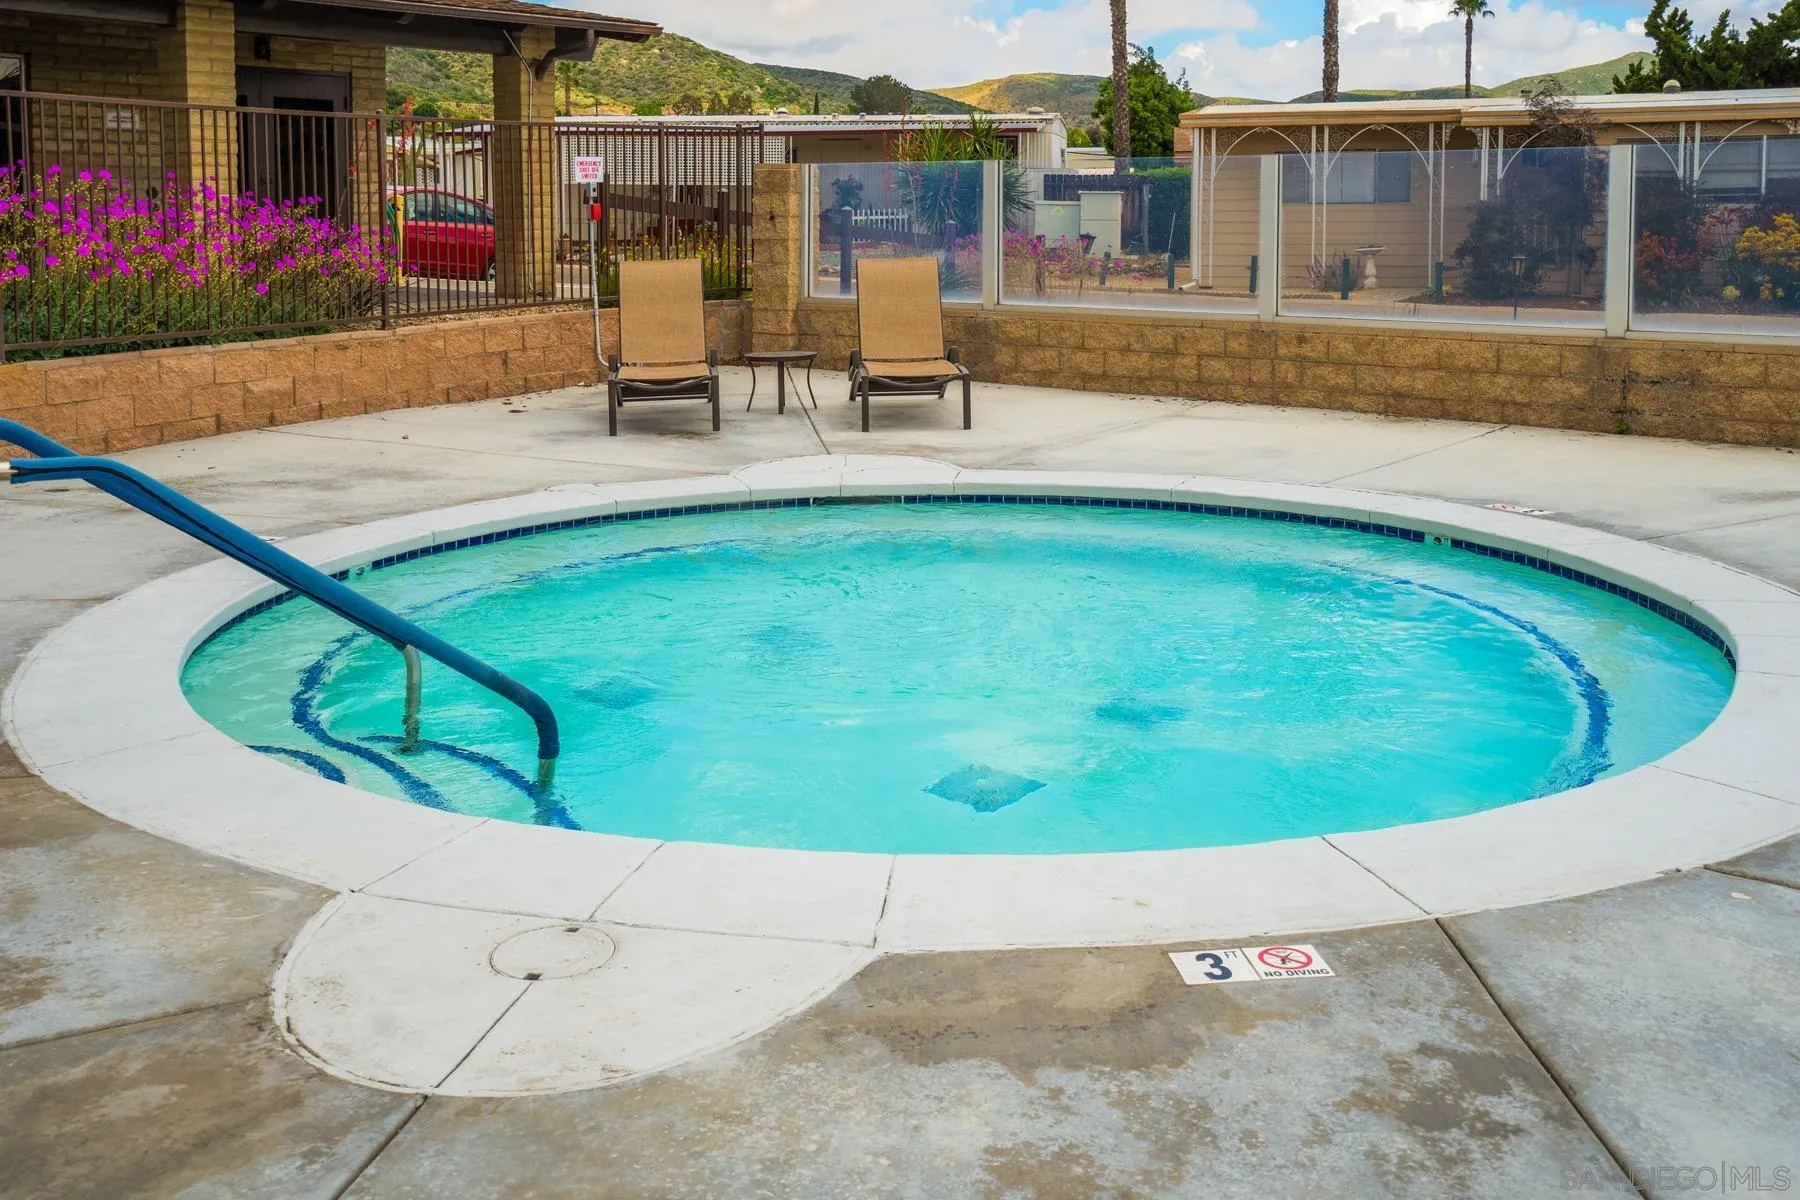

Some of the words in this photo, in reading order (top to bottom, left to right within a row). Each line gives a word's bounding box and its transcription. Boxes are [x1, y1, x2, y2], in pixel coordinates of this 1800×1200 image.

[1196, 953, 1232, 980] 3
[1224, 951, 1238, 959] FT
[1264, 969, 1282, 977] NO
[1287, 968, 1330, 976] DIVING
